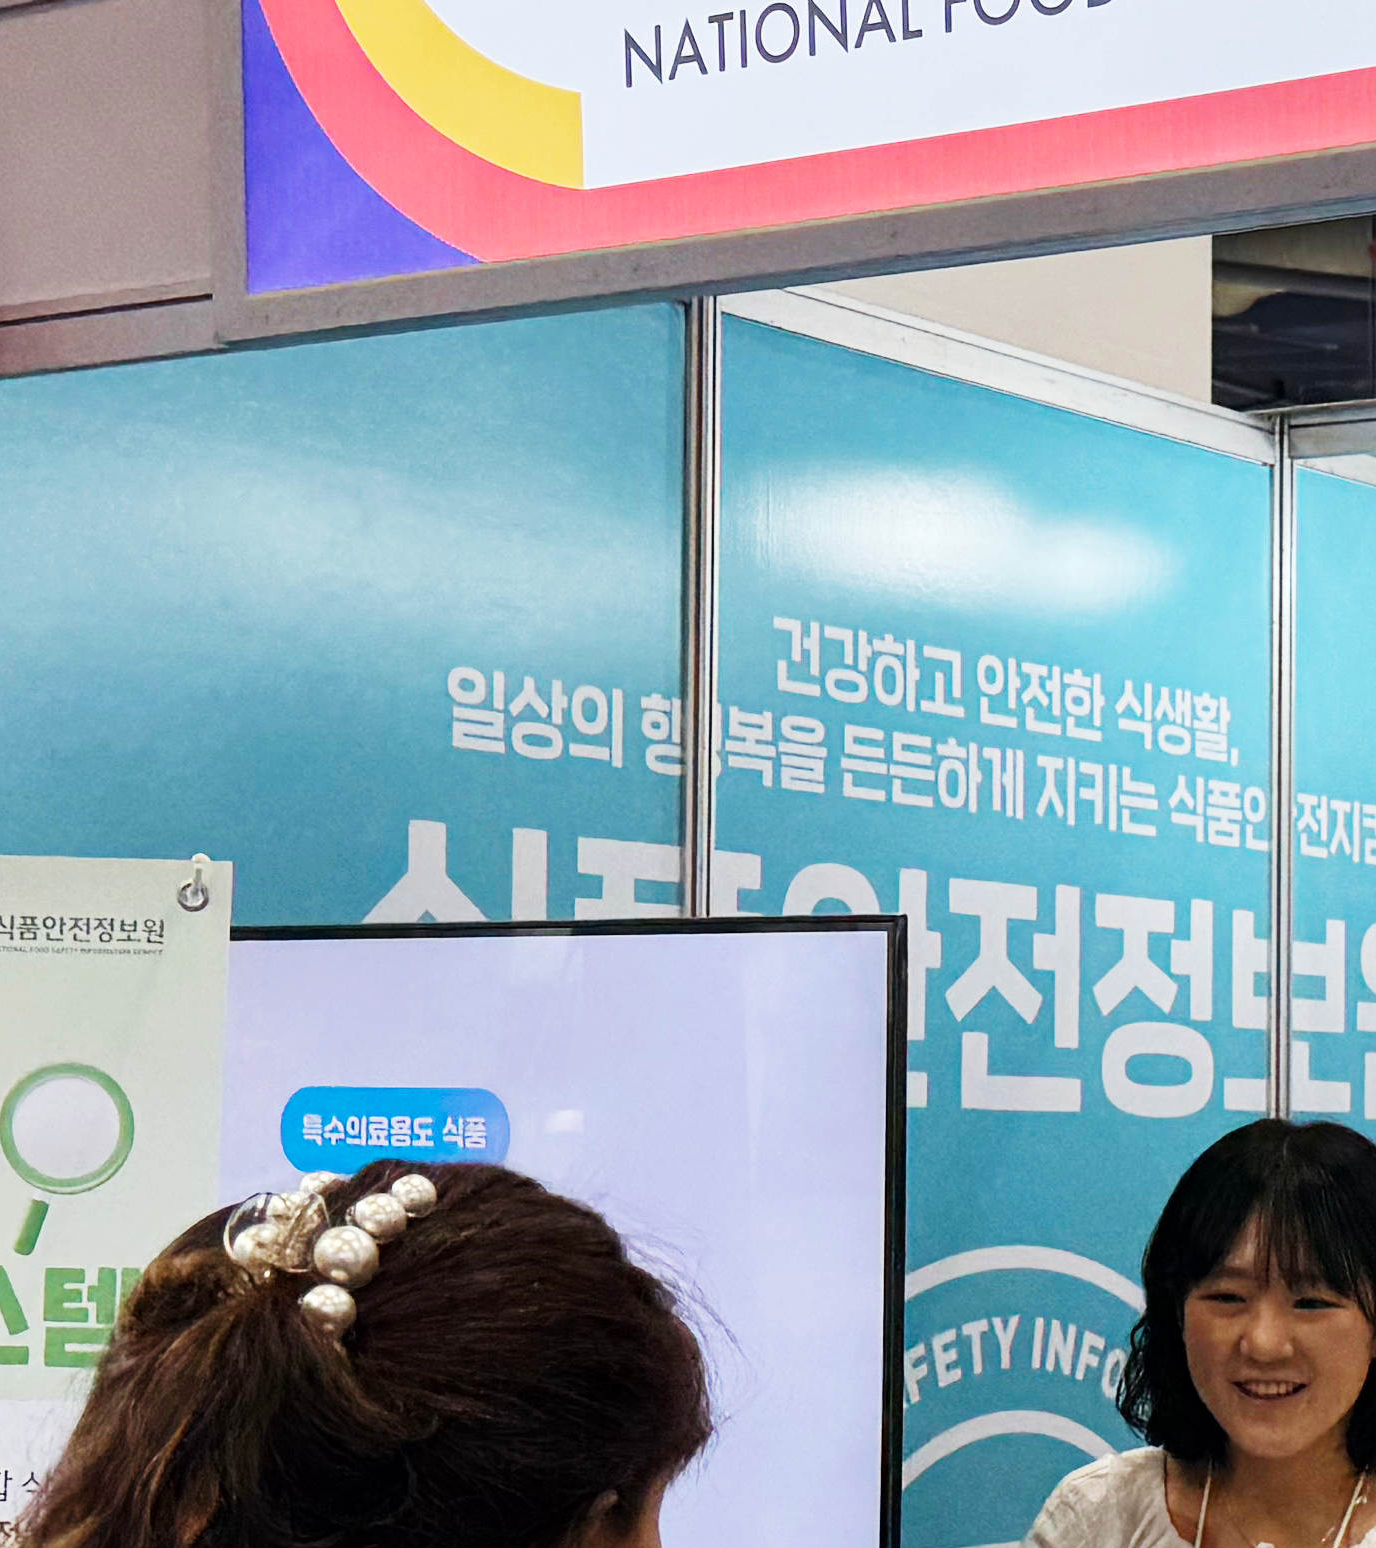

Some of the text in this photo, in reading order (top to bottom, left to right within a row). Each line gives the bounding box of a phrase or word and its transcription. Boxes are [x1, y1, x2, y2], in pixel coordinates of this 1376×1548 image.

[624, 0, 923, 88] NATIONAL
[773, 615, 1239, 767] 건강하고 안전한 식생활,
[447, 666, 623, 769] 일상의
[840, 722, 1025, 821] 든든하게
[1035, 754, 1159, 837] 지키는
[302, 1114, 487, 1149] 특수의료용도 식품
[904, 1314, 1128, 1405] FETY INFO
